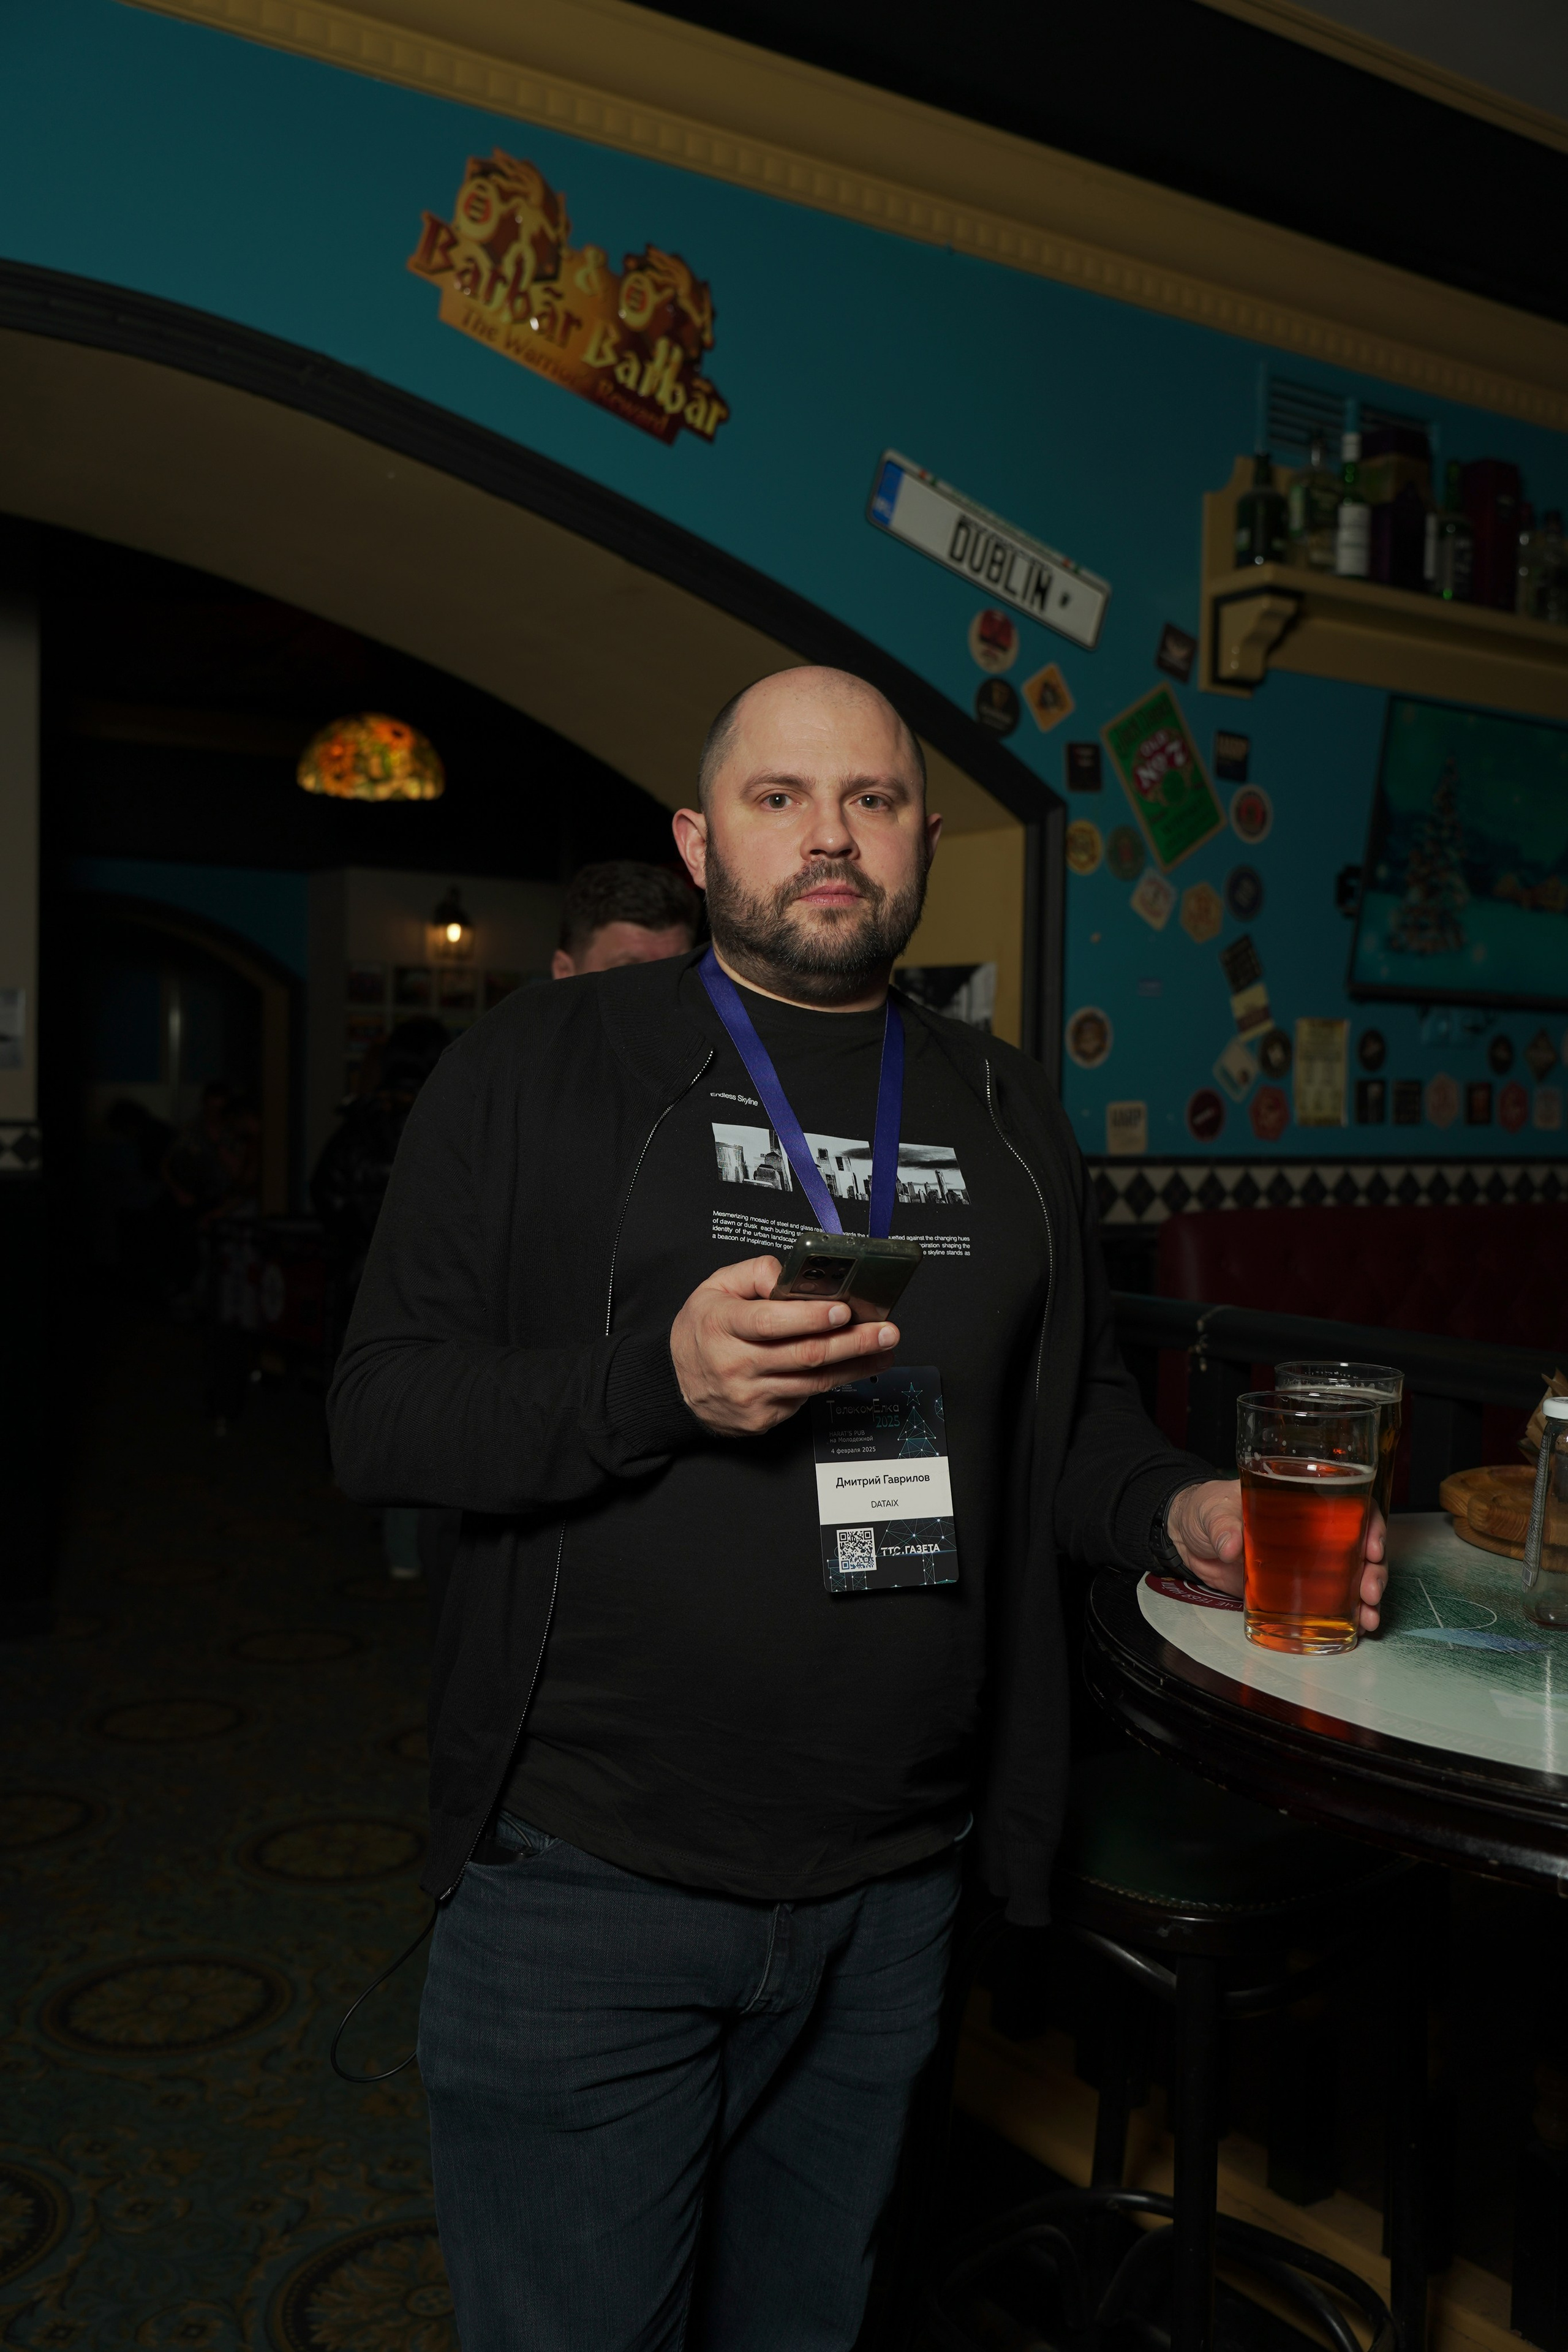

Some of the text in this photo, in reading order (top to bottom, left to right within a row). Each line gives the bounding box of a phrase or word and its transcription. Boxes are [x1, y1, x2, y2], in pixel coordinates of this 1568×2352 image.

[462, 308, 497, 342] The
[949, 519, 1052, 610] DUBLIN
[737, 1095, 758, 1106] Skyline
[713, 1210, 748, 1221] Mesmerizing
[712, 1225, 733, 1234] identity
[775, 1227, 795, 1237] building
[747, 1237, 774, 1247] inspiration
[875, 1414, 900, 1428] 2025
[835, 1475, 930, 1488] Дмитрий Гаврилов
[871, 1499, 899, 1508] DATAIX
[1181, 1593, 1213, 1604] ТЕБЯ
